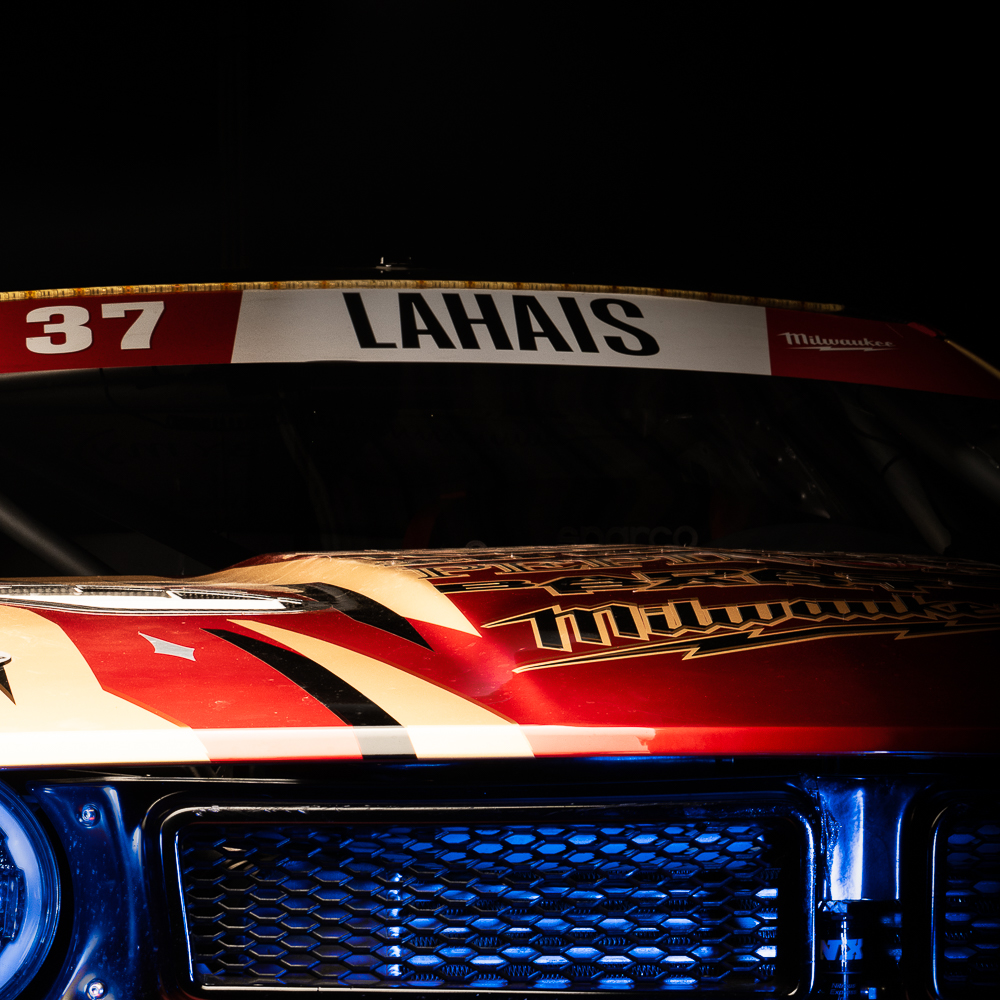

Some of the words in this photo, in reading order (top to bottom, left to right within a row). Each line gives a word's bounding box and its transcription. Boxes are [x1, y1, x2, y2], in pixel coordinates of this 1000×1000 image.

[25, 300, 165, 355] 37
[342, 291, 661, 357] LAHAIS
[776, 331, 896, 347] Milwaukee
